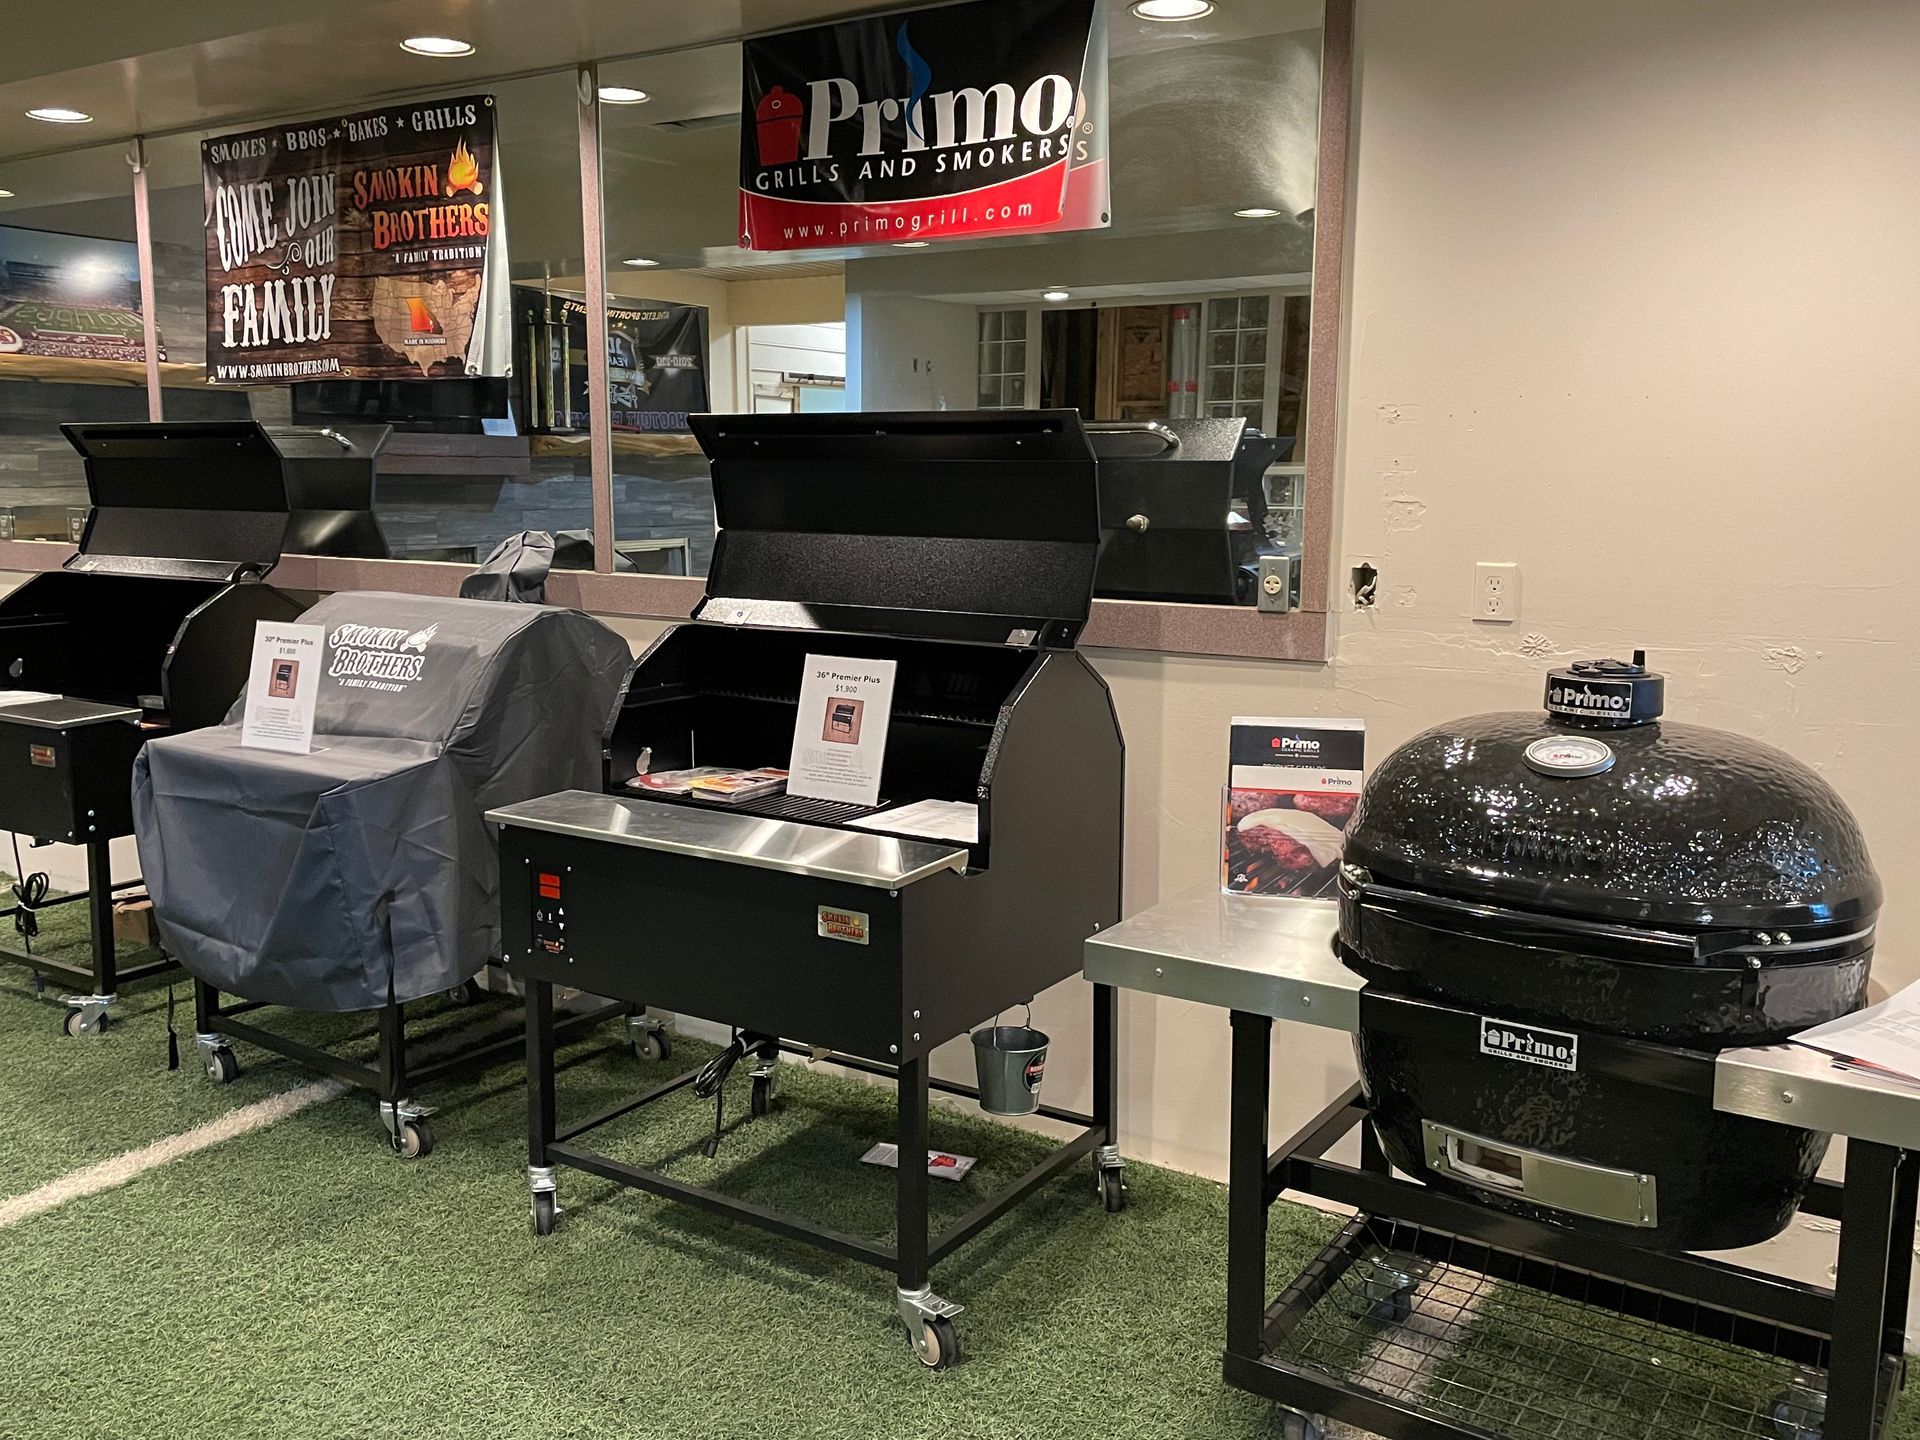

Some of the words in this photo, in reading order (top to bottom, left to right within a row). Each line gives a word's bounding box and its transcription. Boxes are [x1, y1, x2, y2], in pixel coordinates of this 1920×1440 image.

[802, 74, 1073, 160] Primo
[211, 137, 266, 164] SMOKES
[286, 128, 327, 151] BBQS
[349, 116, 388, 142] BAKES
[411, 104, 477, 131] GRILLS
[755, 163, 840, 191] GRILLS
[859, 157, 917, 180] AND
[935, 133, 1070, 174] SMOKERS
[354, 164, 438, 210] SMOKIN
[216, 180, 278, 273] COME
[286, 173, 336, 238] JOIN
[372, 202, 489, 250] BROTHERS
[783, 201, 1033, 240] www.primogrill.com
[305, 227, 335, 269] OUR
[404, 250, 429, 263] FAMILY
[221, 274, 336, 348] FAMILY
[276, 637, 300, 645] Premier
[329, 624, 409, 650] SMOKIN
[329, 647, 425, 681] BROTHERS
[831, 673, 862, 683] Premier
[863, 675, 881, 684] Plus
[835, 684, 857, 693] $1,900
[1550, 706, 1583, 714] CERAMIC
[1563, 687, 1624, 709] Primo
[1282, 738, 1320, 750] Primo
[1328, 777, 1352, 786] Primo
[1488, 1048, 1513, 1057] GRILLS
[1534, 1056, 1568, 1069] SMOKERS
[1502, 1031, 1567, 1059] Primo
